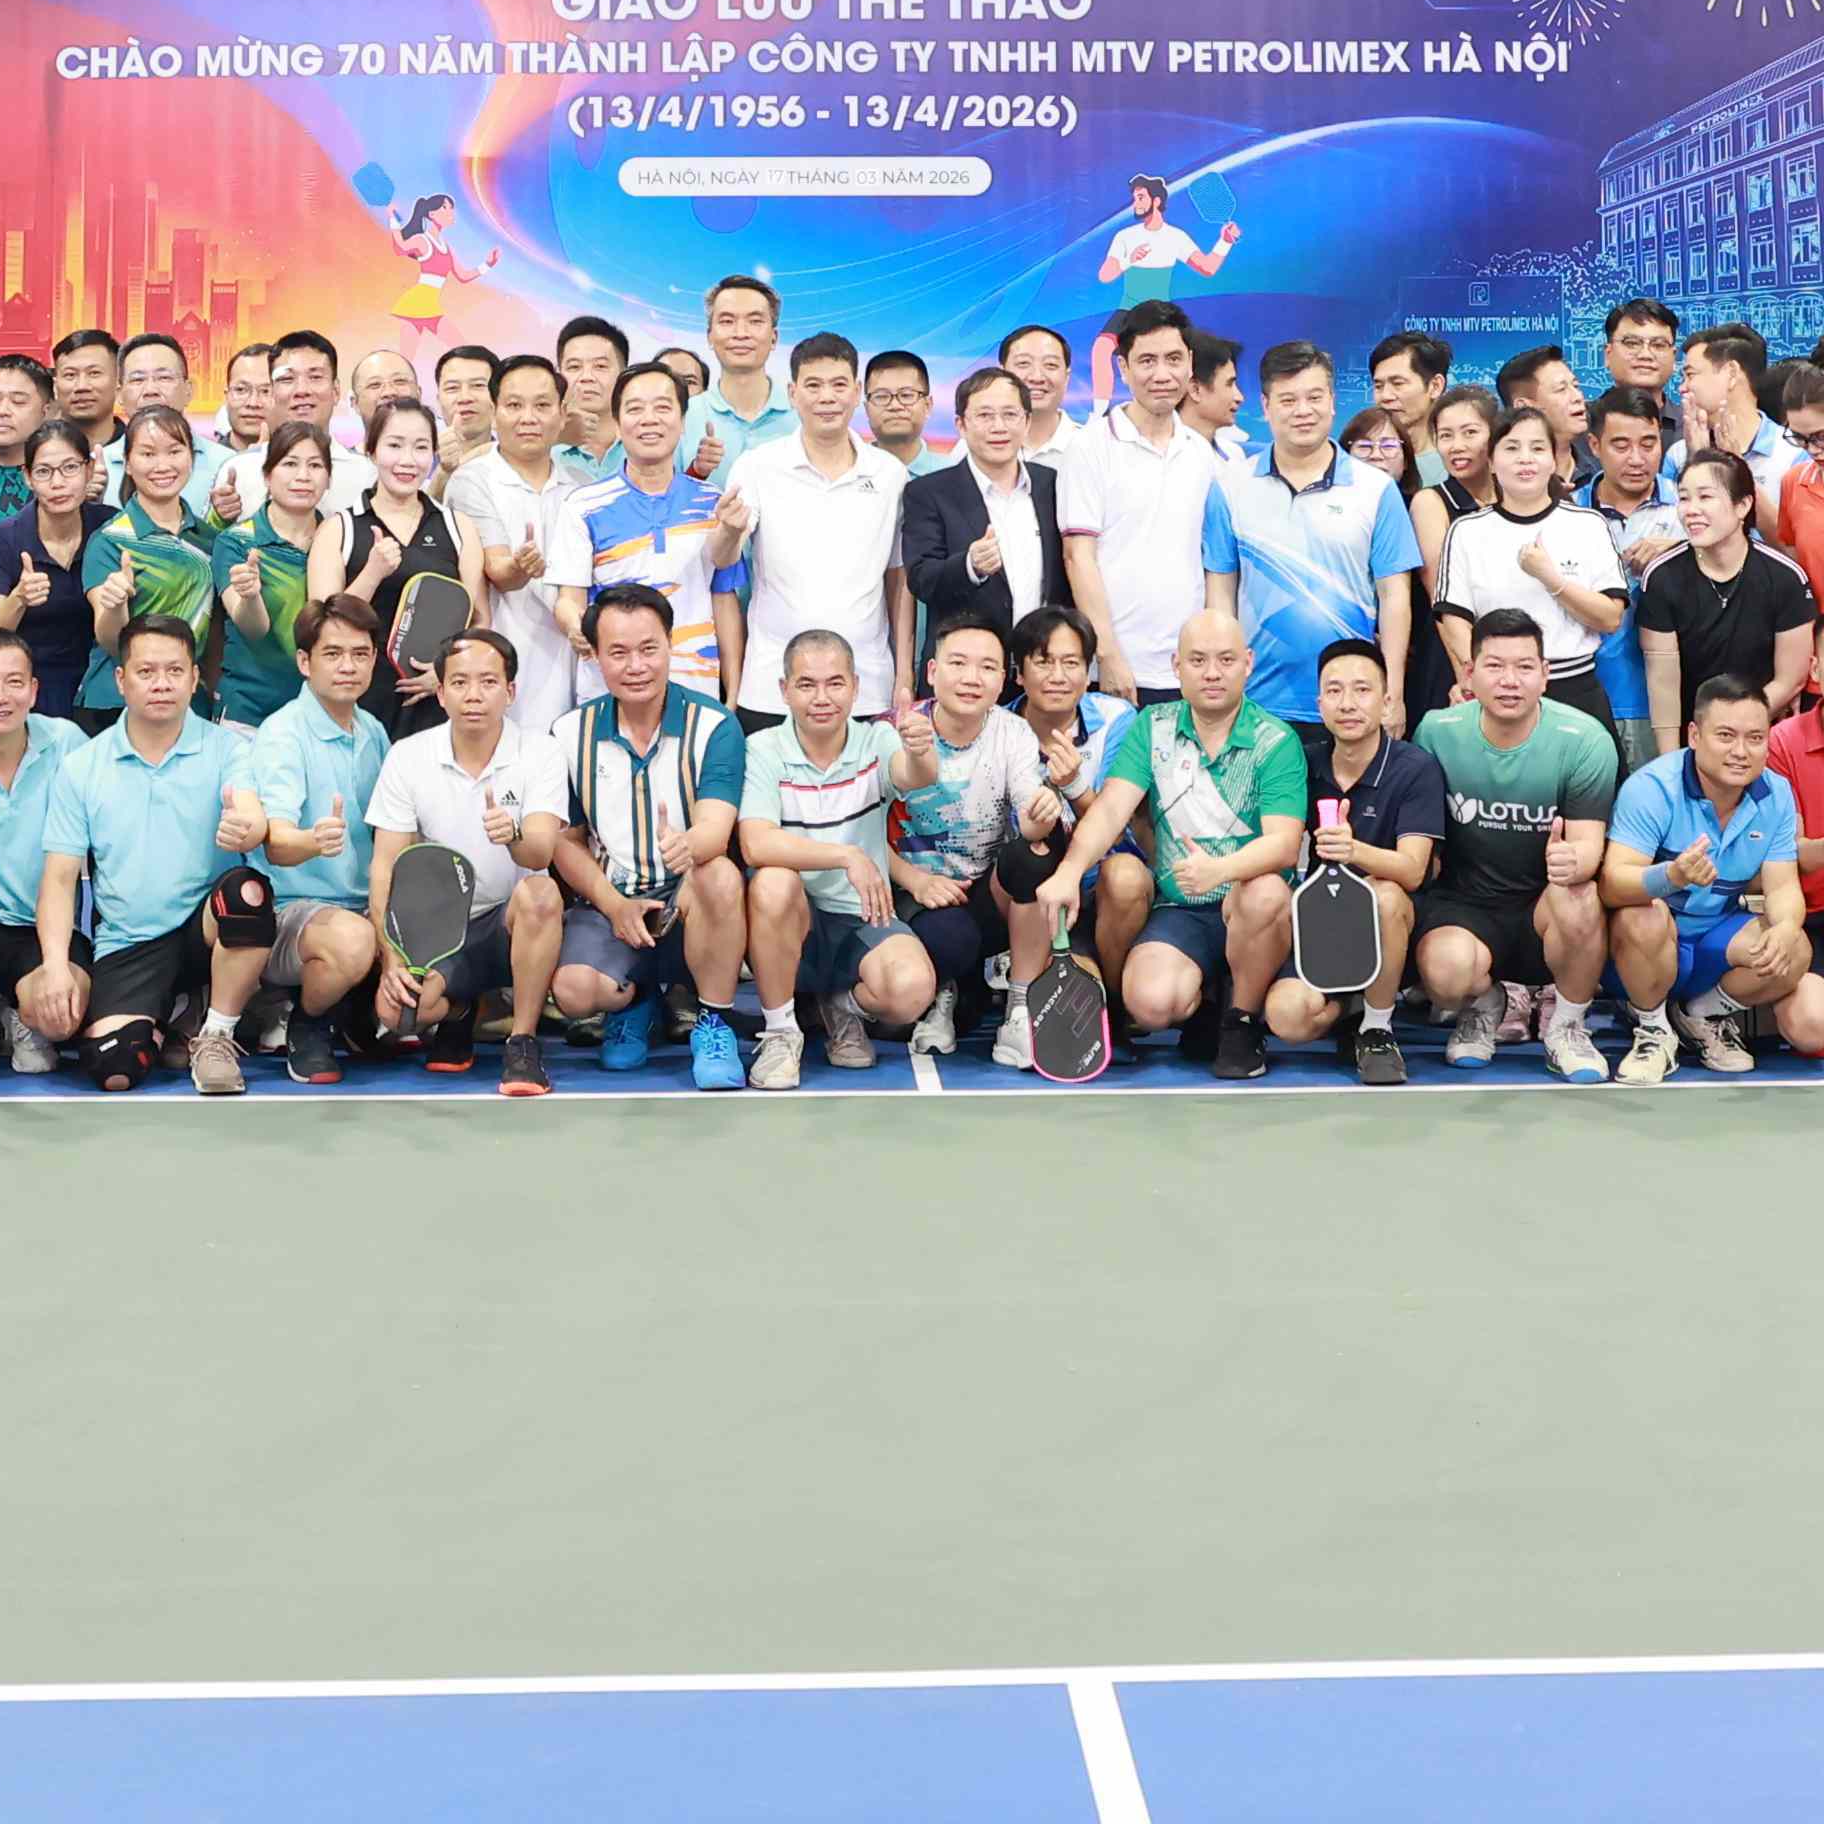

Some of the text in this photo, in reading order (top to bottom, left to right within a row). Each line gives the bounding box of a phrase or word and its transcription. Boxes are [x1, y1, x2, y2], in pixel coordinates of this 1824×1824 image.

[55, 31, 1569, 82] CHÀO MỪNG 70 NĂM THÀNH LẬP CÔNG TY TNHH MTV PETROLIMEX HÀ NỘI
[567, 94, 1079, 138] (13/4/1956 - 13/4/2026)
[1690, 92, 1765, 135] PETROLIMEX
[637, 168, 664, 185] HÀ
[668, 168, 705, 188] NỘI,
[710, 168, 760, 185] NGÀY
[787, 167, 850, 185] THÁNG
[856, 170, 877, 185] 03
[882, 167, 924, 185] NĂM
[929, 170, 971, 185] 2026
[1404, 314, 1427, 332] CÔNG
[1428, 317, 1439, 332] TY
[1441, 317, 1463, 332] TNHH
[1463, 317, 1480, 332] MTV
[1481, 317, 1530, 332] PETROLIMEX
[1531, 313, 1544, 332] HÀ
[1478, 799, 1558, 823] LOTUS
[1478, 820, 1508, 831] PURSUE
[1512, 824, 1533, 832] YOUR
